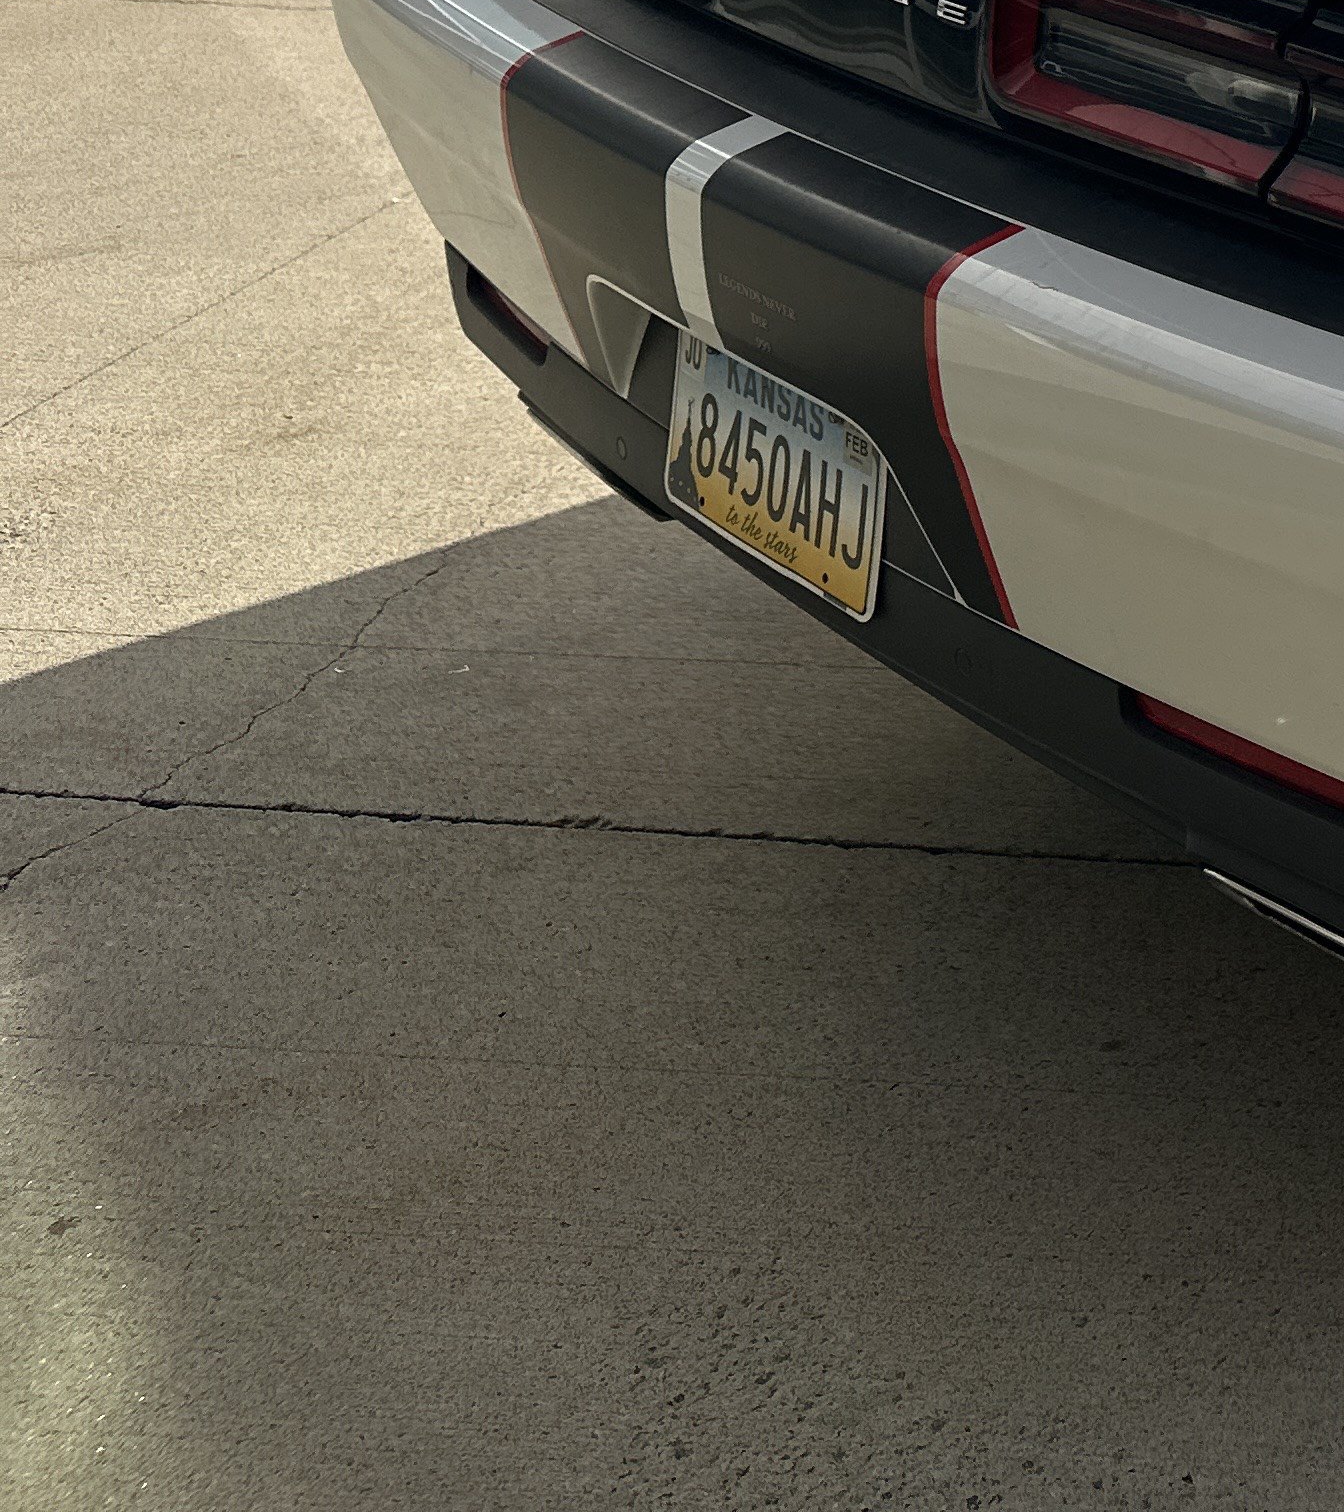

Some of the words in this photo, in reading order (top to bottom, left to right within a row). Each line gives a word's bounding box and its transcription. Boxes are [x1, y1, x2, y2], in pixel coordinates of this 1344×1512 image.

[726, 356, 824, 442] KANSAS
[696, 392, 869, 570] 8450AHJ
[845, 431, 869, 458] FEB
[725, 504, 739, 526] to
[740, 514, 763, 541] the
[763, 530, 798, 564] stars
